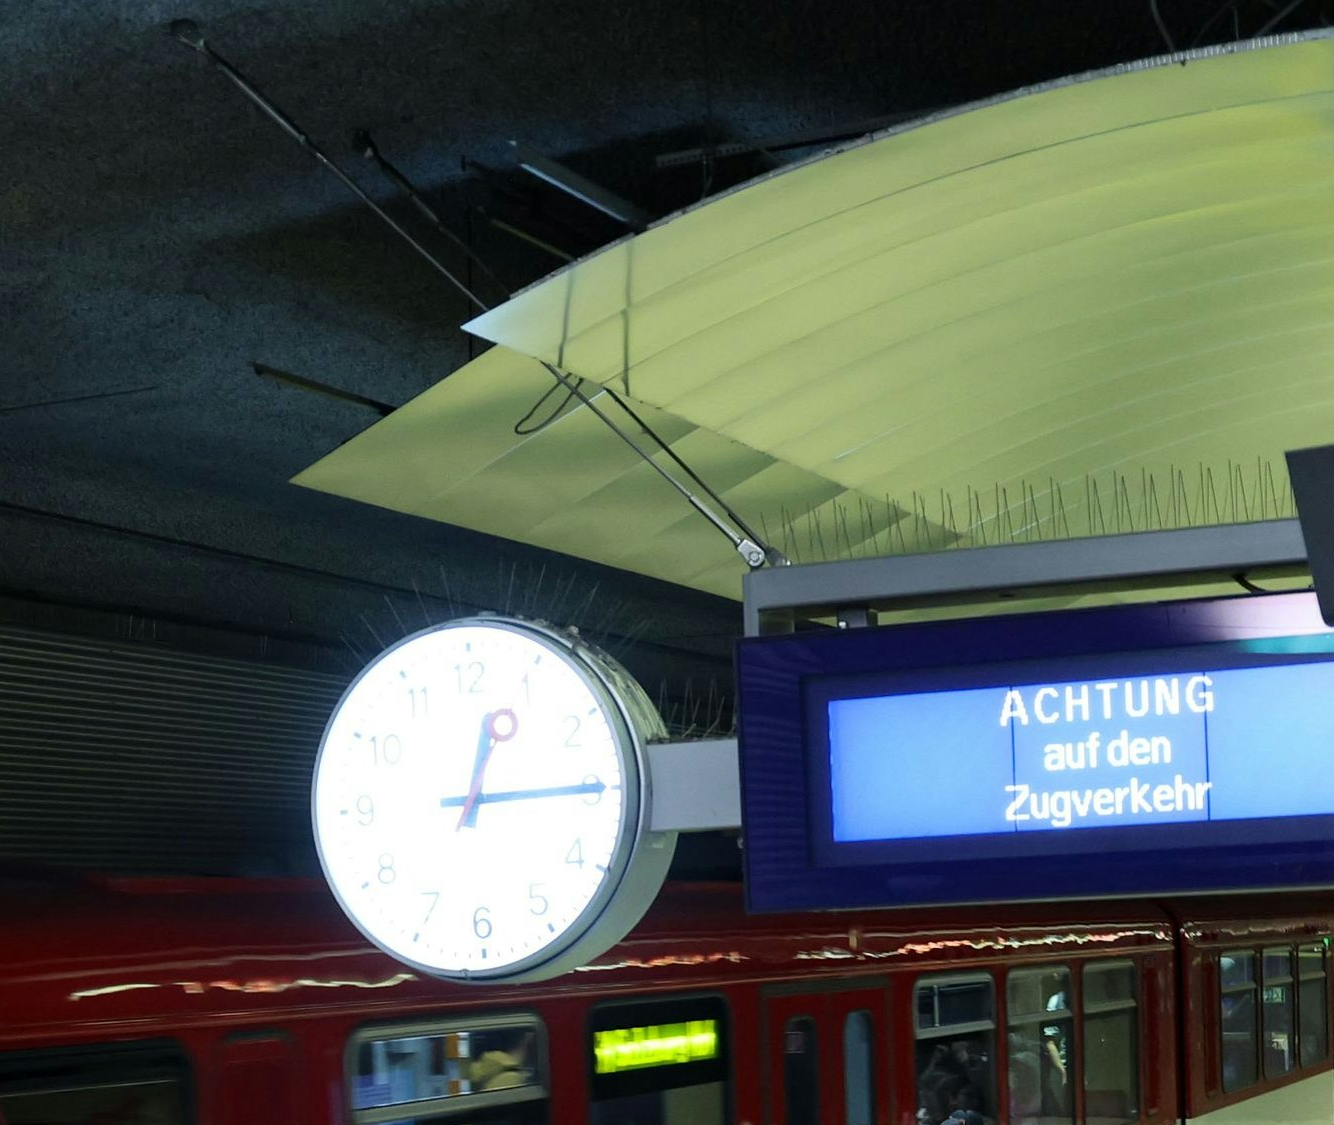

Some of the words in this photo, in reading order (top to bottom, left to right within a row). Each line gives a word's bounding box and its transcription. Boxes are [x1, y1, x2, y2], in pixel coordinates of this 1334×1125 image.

[454, 661, 485, 695] 12
[408, 686, 429, 718] 11
[999, 675, 1215, 727] ACHTUNG
[563, 714, 582, 748] 2
[369, 733, 402, 766] 10
[1043, 731, 1099, 771] auf
[1107, 730, 1172, 768] den
[356, 794, 375, 827] 9
[1004, 776, 1212, 828] Zugverkehr
[377, 852, 396, 885] 8
[565, 837, 585, 869] 4
[420, 891, 440, 926] 7
[528, 882, 549, 916] 5
[472, 906, 493, 939] 6
